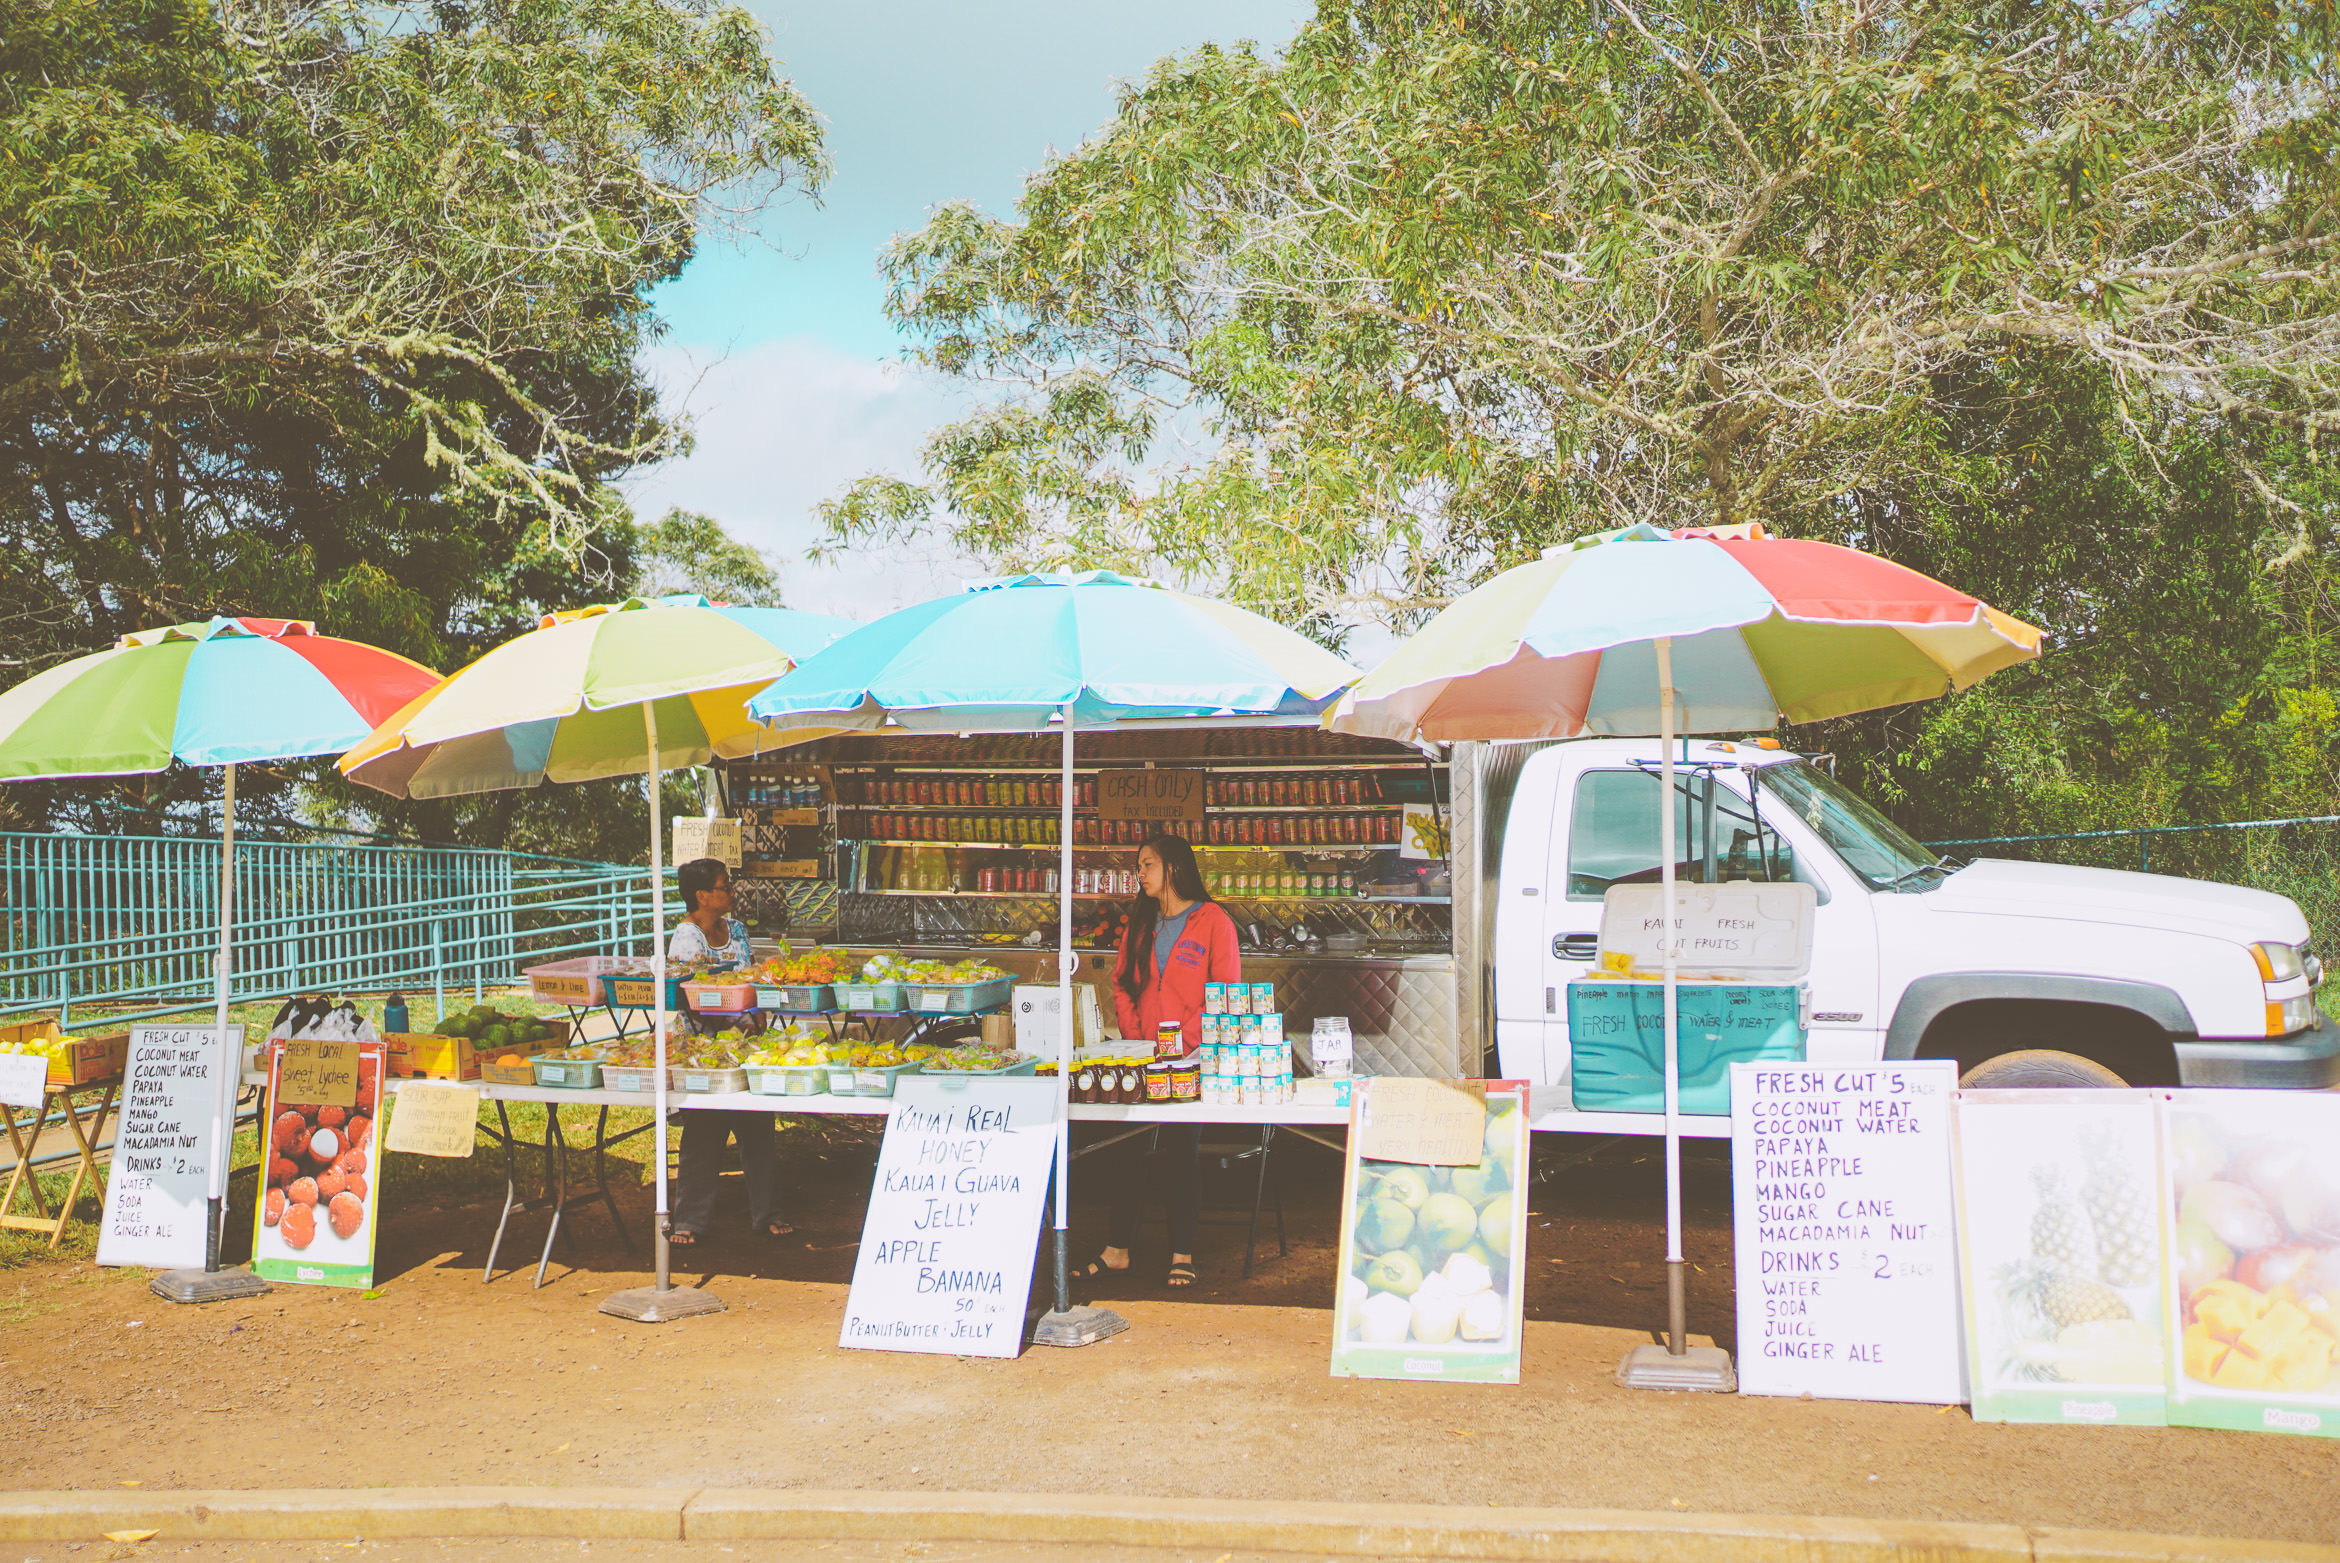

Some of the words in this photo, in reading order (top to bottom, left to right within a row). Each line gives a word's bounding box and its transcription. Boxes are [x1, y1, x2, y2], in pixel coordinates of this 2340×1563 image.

[1108, 775, 1147, 798] CASH
[1155, 772, 1193, 802] ONLY
[1718, 918, 1755, 929] FRESH
[1694, 937, 1740, 950] FRUITS
[1582, 1014, 1625, 1037] FRESH
[1689, 1010, 1721, 1027] WATER
[1737, 1016, 1776, 1030] MEAT
[144, 1031, 169, 1043] FRESH
[172, 1031, 190, 1043] CUT
[1317, 1039, 1342, 1051] JAR
[136, 1047, 176, 1062] COCONUT
[180, 1050, 200, 1062] MEAT
[286, 1043, 311, 1057] FRESH
[134, 1064, 177, 1078] COCONUT
[180, 1065, 208, 1079] WATER
[132, 1080, 163, 1094] PAPAYA
[1756, 1072, 1824, 1094] FRESH
[1834, 1073, 1877, 1093] CUT
[131, 1095, 174, 1107] PINEAPPLE
[1372, 1085, 1416, 1103] FRESH
[129, 1108, 158, 1120] MANGO
[1752, 1101, 1841, 1117] COCONUT
[1859, 1100, 1912, 1118] MEAT
[966, 1104, 1020, 1133] REAL
[1372, 1112, 1417, 1128] WATER
[1753, 1119, 1844, 1135] COCONUT
[1856, 1118, 1921, 1134] WATER
[125, 1121, 154, 1134] SUGAR
[157, 1121, 181, 1133] CANE
[123, 1136, 175, 1149] MACADAMIA
[178, 1133, 197, 1148] NUT
[1755, 1137, 1828, 1156] PAPAYA
[918, 1138, 993, 1165] HONEY
[127, 1155, 162, 1173] DRINKS
[188, 1165, 205, 1176] EACH
[1755, 1157, 1863, 1180] PINEAPPLE
[120, 1178, 153, 1190] WATER
[884, 1168, 946, 1192] KAUAI
[955, 1167, 1020, 1193] GUAVA
[1755, 1182, 1826, 1201] MANGO
[117, 1194, 142, 1209] SODA
[115, 1211, 142, 1223] JUICE
[914, 1198, 980, 1230] JELLY
[1758, 1203, 1819, 1223] SUGAR
[1837, 1200, 1895, 1219] CANE
[113, 1224, 149, 1237] GINGER
[156, 1225, 174, 1238] ALE
[1759, 1225, 1871, 1243] MACADAMIA
[1890, 1223, 1928, 1241] NUT
[875, 1240, 942, 1264] APPLE
[1761, 1250, 1840, 1274] DRINKS
[917, 1267, 1002, 1295] BANANA
[1762, 1280, 1822, 1296] WATER
[1766, 1299, 1808, 1317] SODA
[951, 1319, 993, 1339] JELLY
[1764, 1321, 1817, 1337] JUICE
[1763, 1341, 1835, 1360] GINGER
[1848, 1344, 1884, 1363] ALE
[1405, 1359, 1441, 1371] Coconut
[2268, 1411, 2319, 1428] Mango
